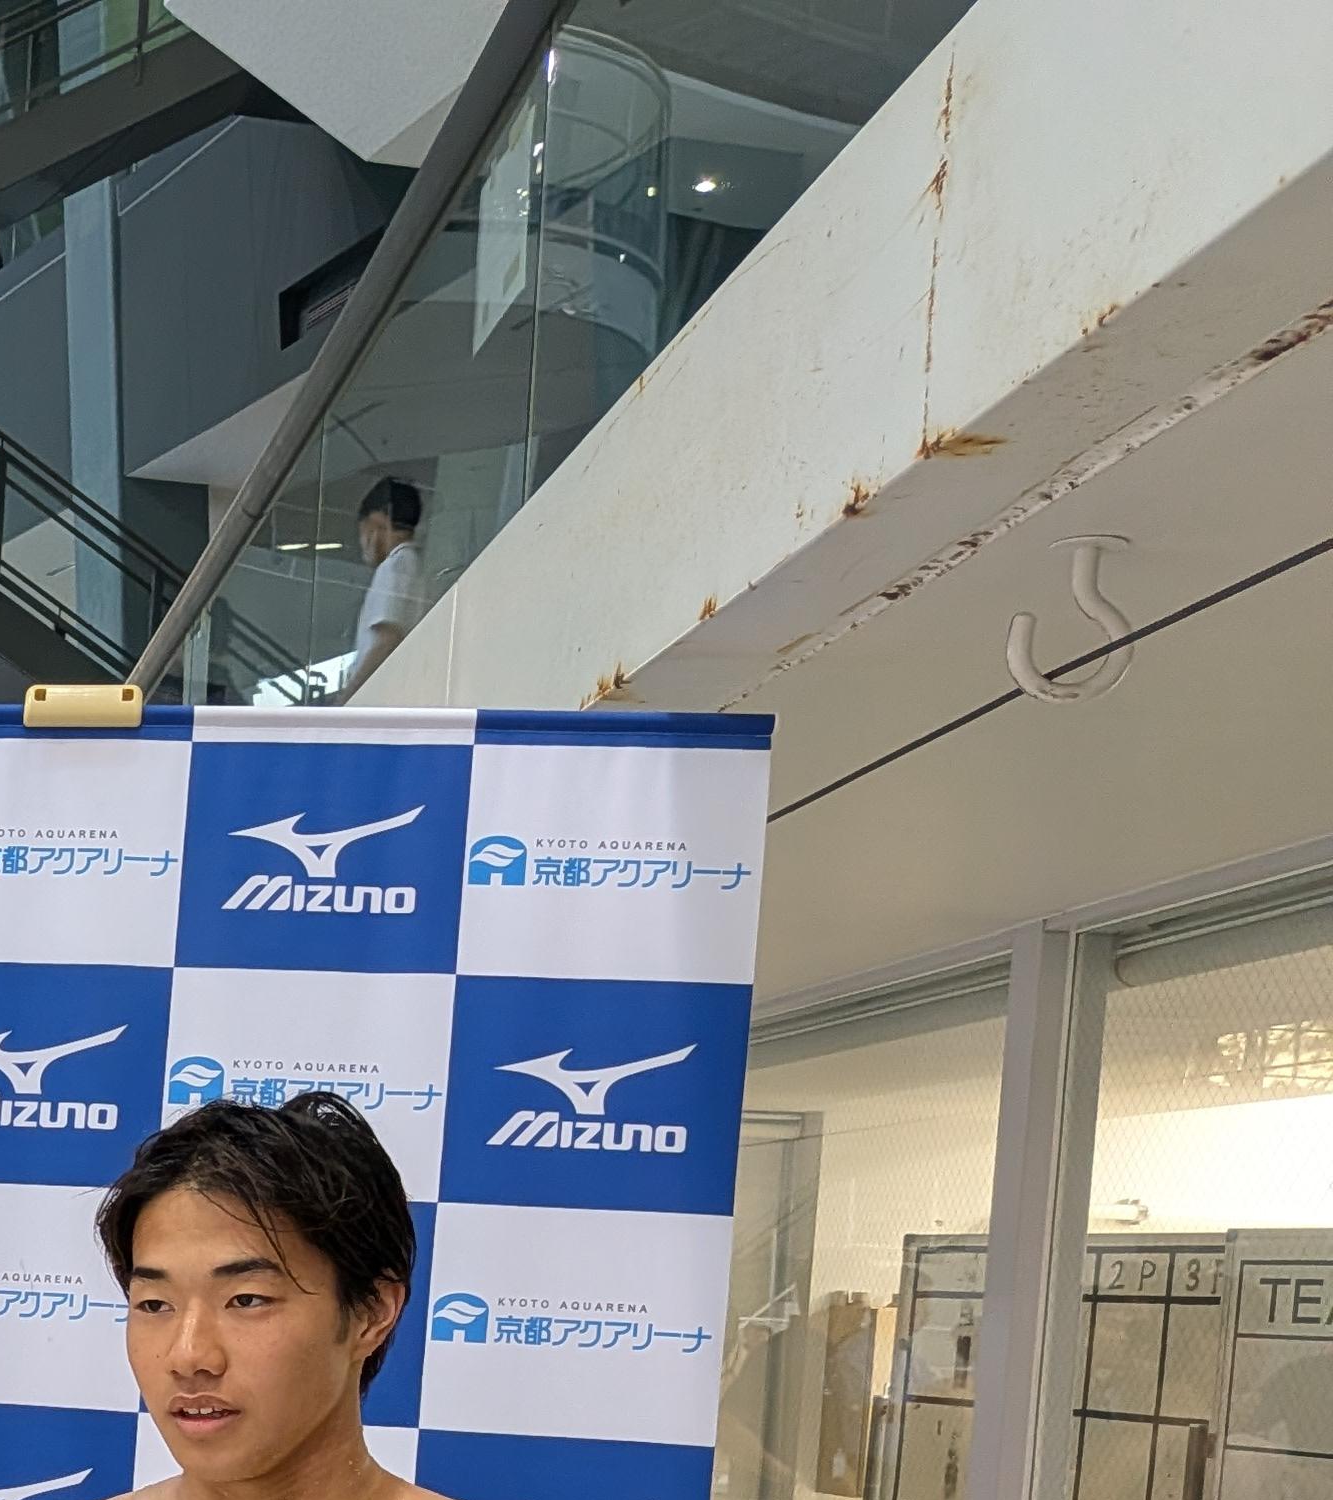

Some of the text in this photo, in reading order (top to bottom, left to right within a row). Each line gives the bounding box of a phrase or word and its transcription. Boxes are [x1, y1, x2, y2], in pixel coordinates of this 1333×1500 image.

[34, 828, 119, 839] AQUARENA
[535, 838, 688, 852] KYOTO AQUARENA
[533, 857, 752, 890] 京都アクアリーナ
[221, 875, 417, 915] MIZUNO
[232, 1058, 380, 1074] KYOTO AQUARENA
[486, 1111, 687, 1154] MIZUNO
[2, 1272, 84, 1285] AQUARENA
[498, 1297, 649, 1314] KYOTO AQUARENA
[1260, 1278, 1333, 1325] TE
[495, 1315, 712, 1354] 京都アクアリーナ
